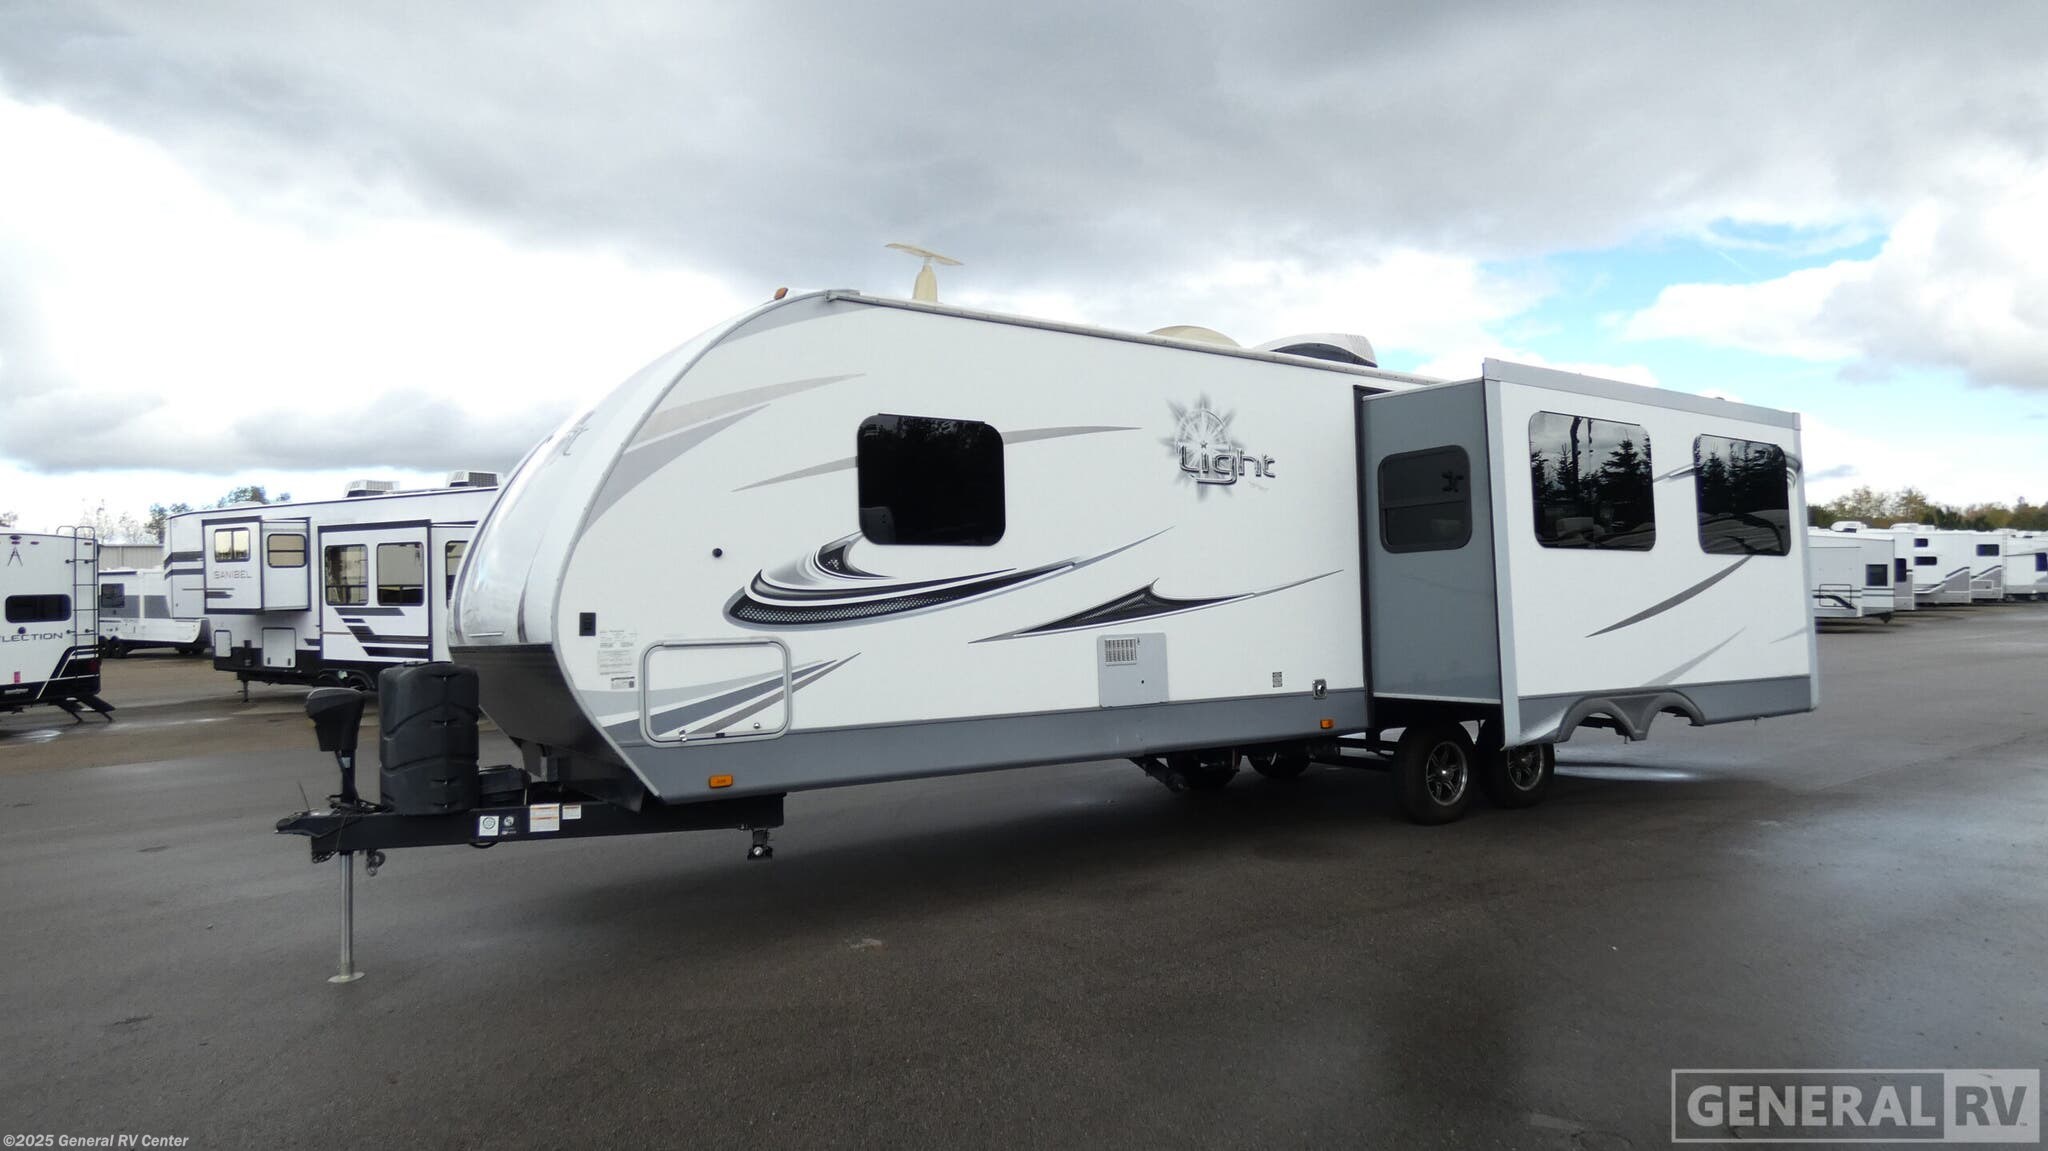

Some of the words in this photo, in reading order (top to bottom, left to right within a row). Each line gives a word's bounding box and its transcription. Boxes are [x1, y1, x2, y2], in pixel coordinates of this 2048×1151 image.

[1178, 441, 1276, 485] Light
[214, 570, 253, 579] SANIBEL
[0, 632, 63, 643] LECTION
